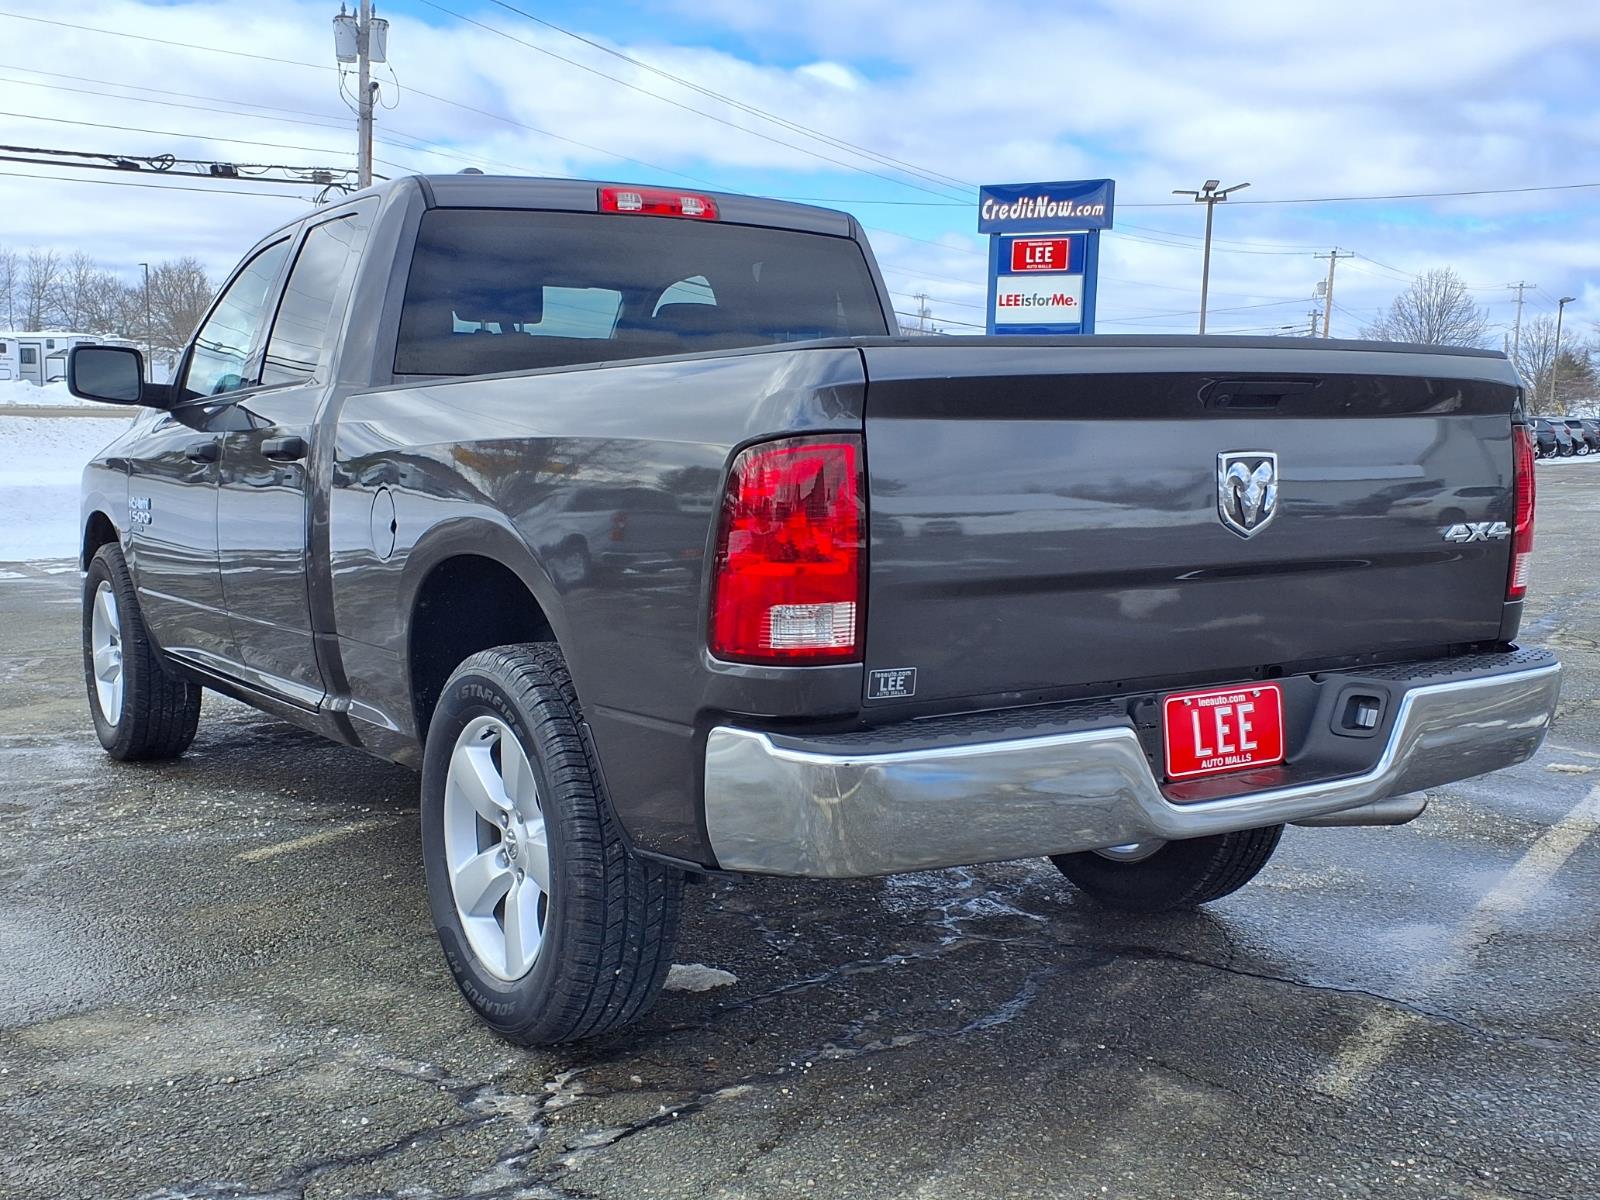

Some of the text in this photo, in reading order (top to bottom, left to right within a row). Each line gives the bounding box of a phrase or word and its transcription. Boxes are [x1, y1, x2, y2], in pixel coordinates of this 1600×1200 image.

[981, 196, 1104, 220] CreditNow.com
[1025, 247, 1054, 263] LEE
[998, 293, 1078, 307] LEEisforMe.
[880, 676, 905, 691] LEE
[1198, 694, 1246, 707] leeauto.com
[1191, 702, 1258, 758] LEE
[1201, 753, 1252, 769] AUTO MALLS
[462, 980, 517, 1016] SOLARUS
